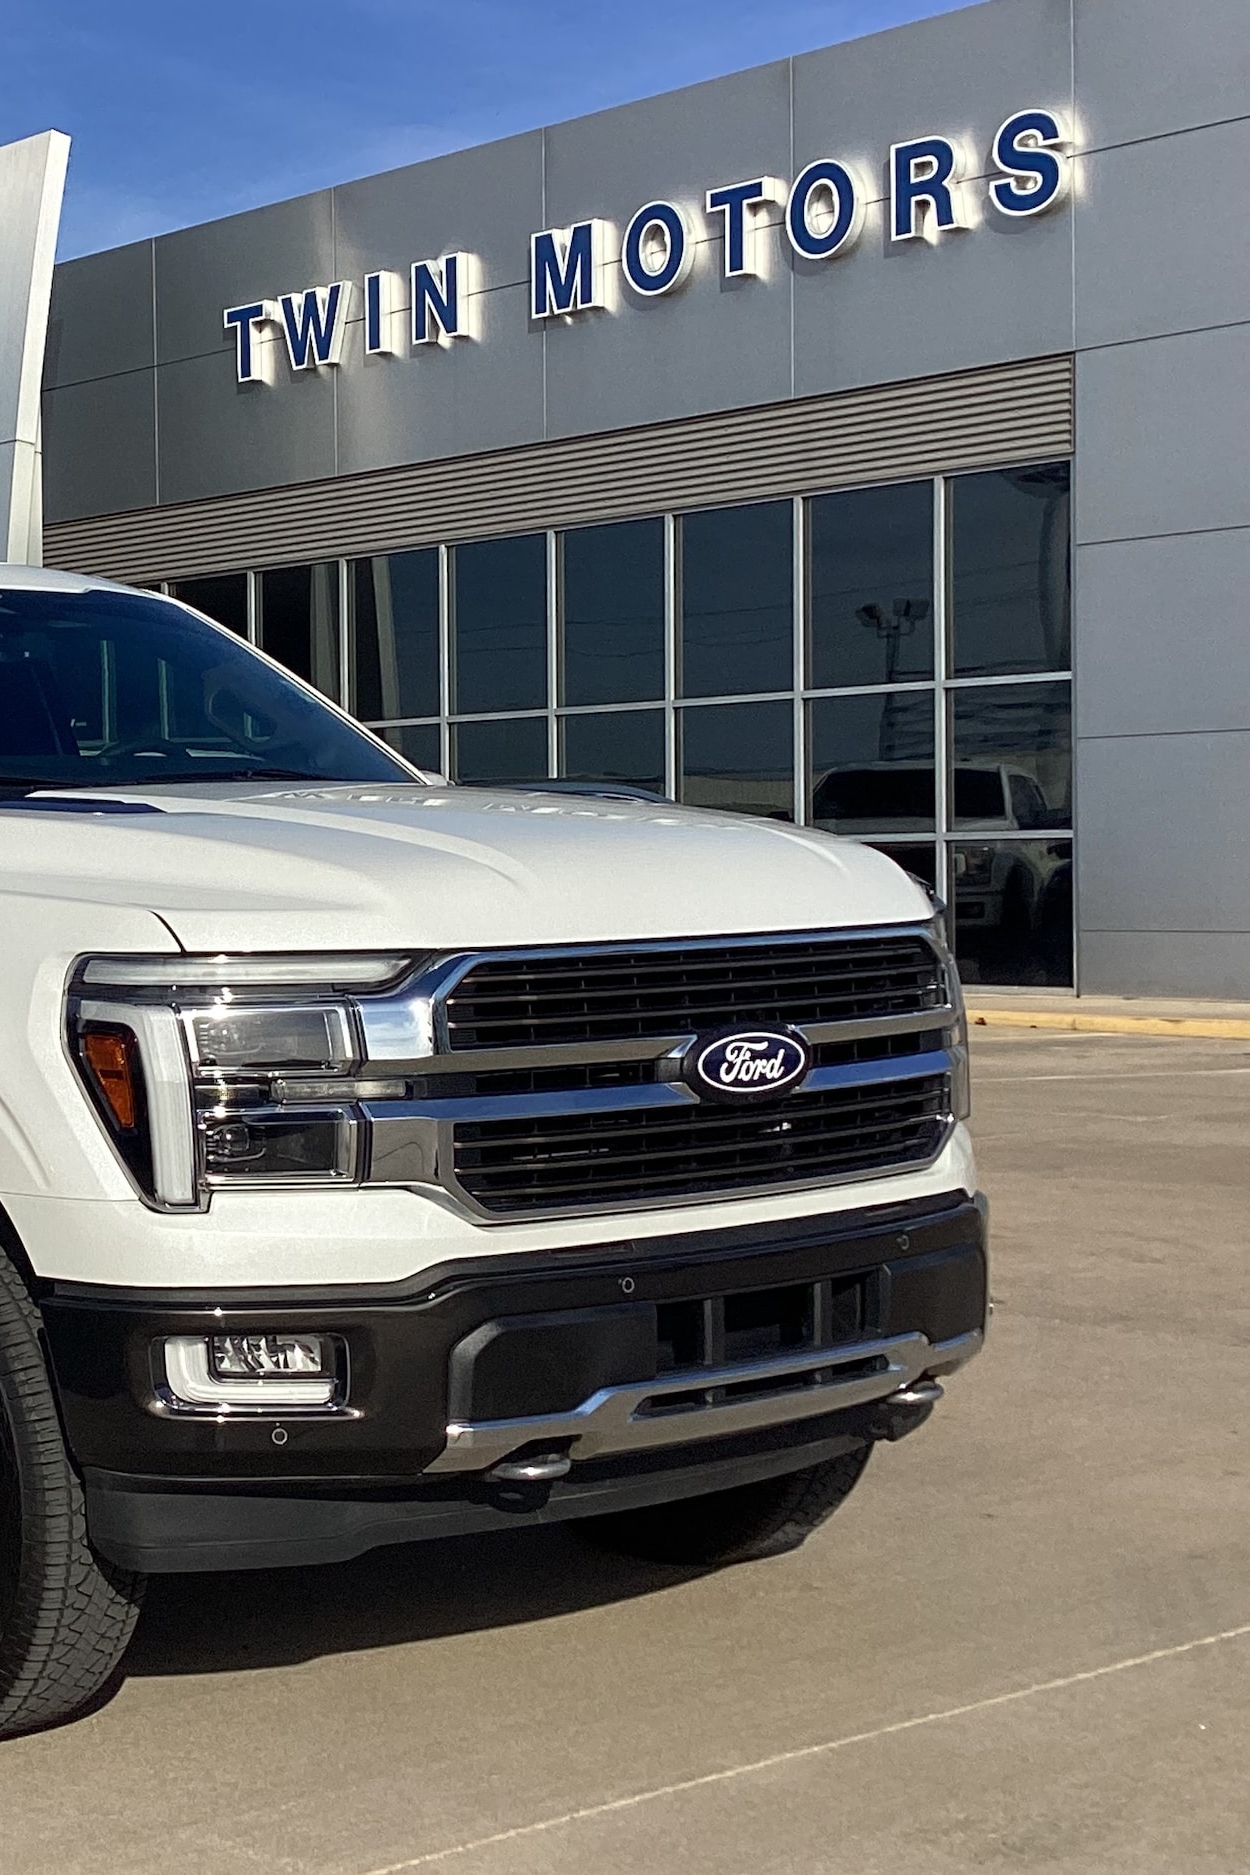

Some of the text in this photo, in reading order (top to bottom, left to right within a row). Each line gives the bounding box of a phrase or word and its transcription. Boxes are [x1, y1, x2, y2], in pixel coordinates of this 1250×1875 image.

[224, 108, 1072, 383] TWIN MOTORS
[720, 1041, 785, 1083] Ford
